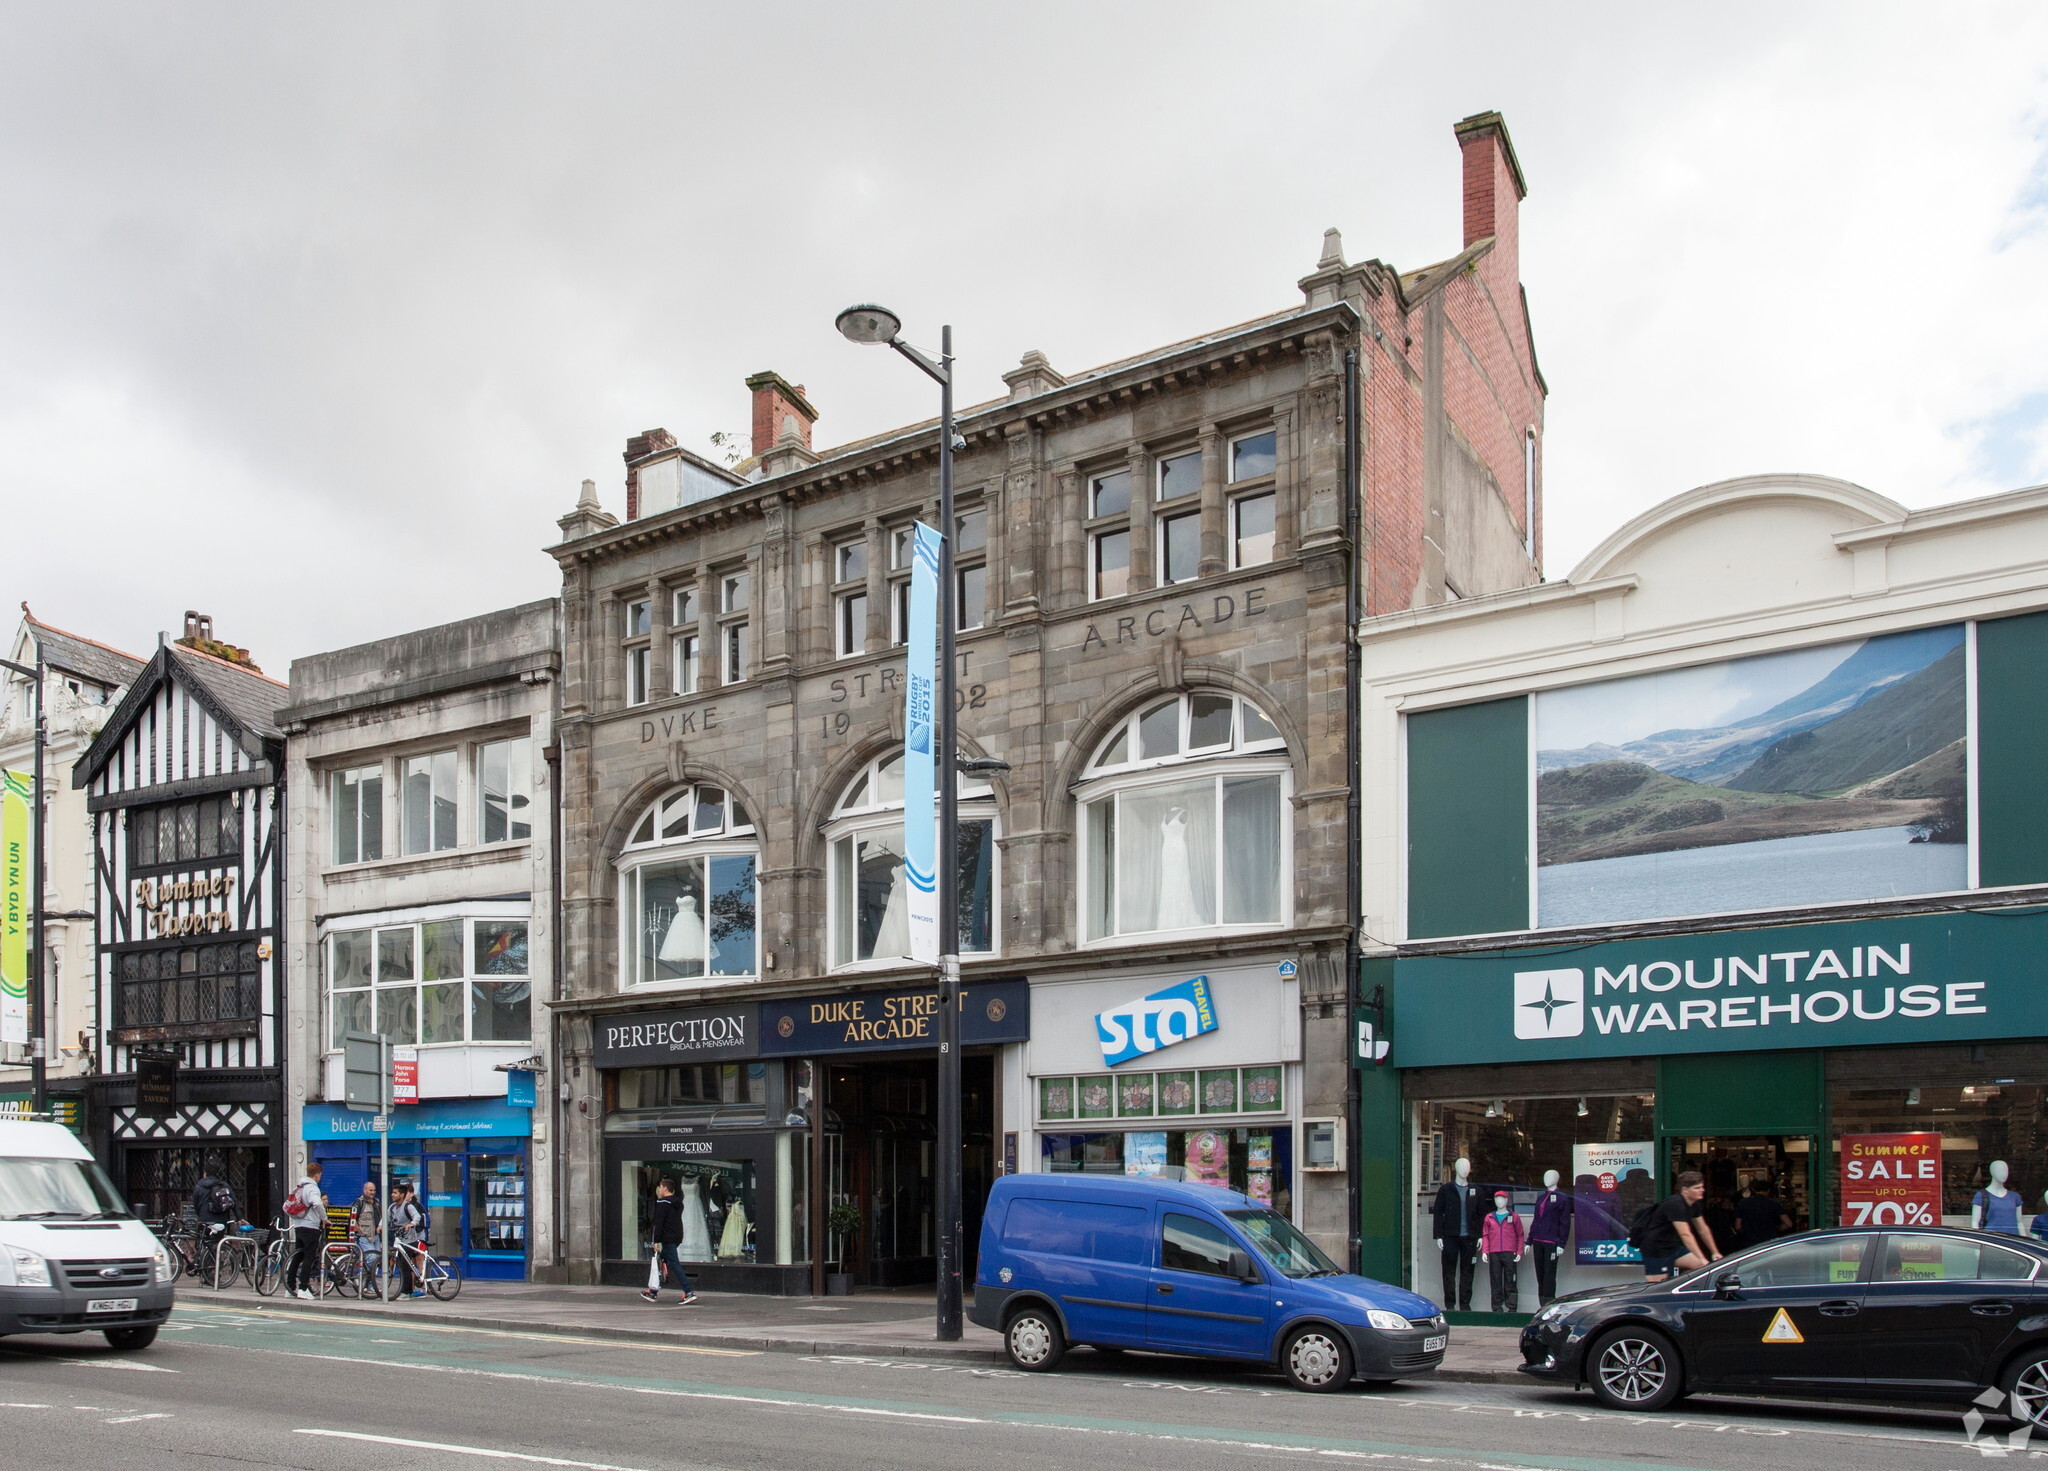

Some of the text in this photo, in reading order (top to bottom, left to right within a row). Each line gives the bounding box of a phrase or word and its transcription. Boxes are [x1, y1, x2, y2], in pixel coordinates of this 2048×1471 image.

[1081, 586, 1267, 651] ARCADE
[830, 649, 974, 703] STRT
[911, 673, 919, 719] RUGBY
[922, 679, 931, 723] 2015
[822, 713, 850, 738] 19
[9, 842, 20, 935] Y BYD YN UN
[136, 876, 235, 910] Rummer
[150, 908, 232, 937] Tavern
[1595, 943, 1910, 995] MOUNTAIN
[811, 991, 968, 1024] DUKE STRET
[1192, 978, 1213, 1030] TRAVEL
[1591, 981, 1987, 1035] WAREHOUSE
[606, 1015, 746, 1050] PERFECTION
[844, 1017, 930, 1042] ARCADE
[1100, 997, 1198, 1055] sta
[669, 1038, 745, 1051] BRIDAL & MENSWEAR
[941, 1044, 948, 1053] 3
[141, 1083, 171, 1092] RUMMER
[144, 1095, 169, 1103] TAVERN
[331, 1117, 395, 1132] blueArw
[416, 1121, 493, 1134] Delivering Recruitment Solutions
[661, 1142, 713, 1152] PERFECTION
[1852, 1143, 1930, 1156] Summer
[1589, 1158, 1642, 1167] SOFTSHELL
[1847, 1159, 1936, 1180] SALE
[1875, 1188, 1907, 1196] UP TO
[1847, 1201, 1933, 1226] 70%
[1595, 1243, 1640, 1259] £24.
